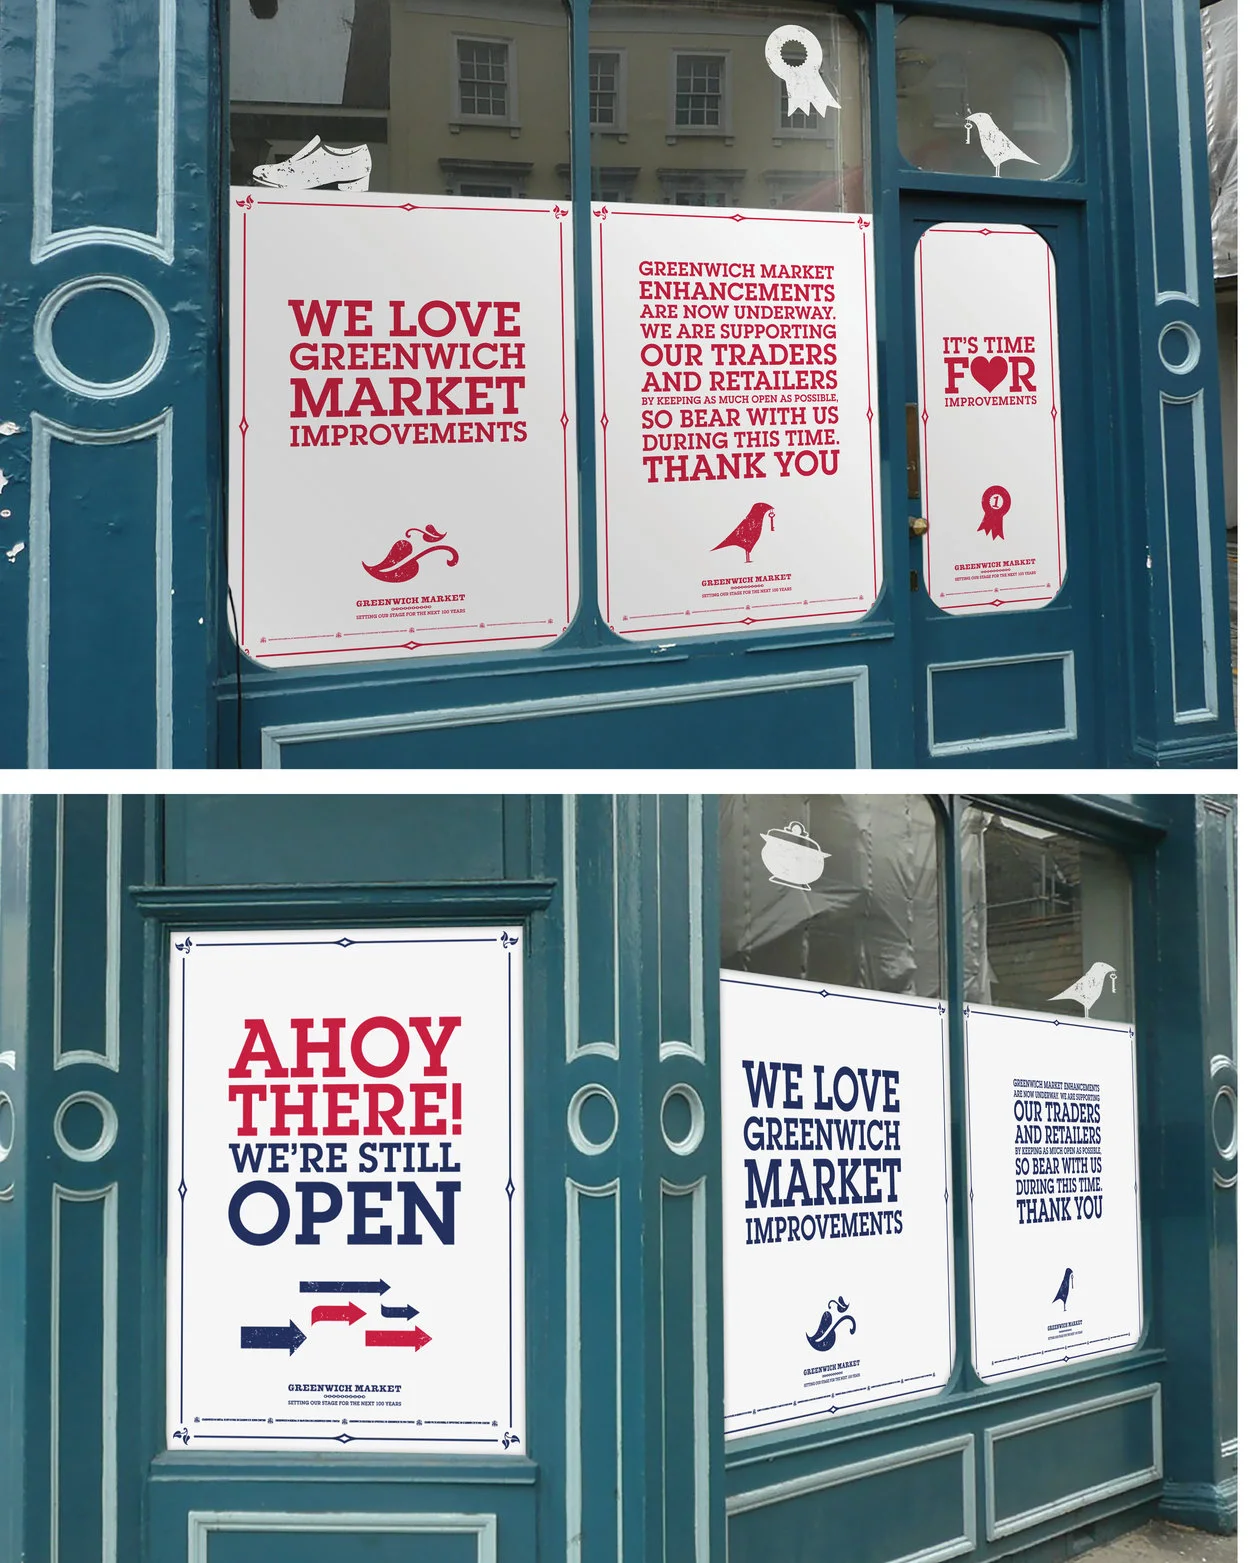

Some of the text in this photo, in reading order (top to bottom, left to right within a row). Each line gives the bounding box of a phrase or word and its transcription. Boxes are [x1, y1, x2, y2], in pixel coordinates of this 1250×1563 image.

[639, 261, 835, 280] GREENWICH MARKET
[639, 281, 835, 303] ENHANCEMENTS
[288, 299, 521, 338] WE LOVE
[640, 304, 836, 320] ARE NOW UNDERWAY.
[640, 323, 837, 339] WE ARE SUPPORTING
[290, 342, 526, 371] GREENWICH
[641, 343, 837, 367] OUR TRADERS
[943, 336, 1035, 354] IT'S TIME
[641, 370, 838, 393] AND RETAILERS
[290, 376, 526, 418] MARKET
[642, 394, 839, 406] BY KEEPING AS MUCH OPEN AS POSSIBLE,
[945, 395, 1037, 407] IMPROVEMENTS
[642, 406, 839, 429] SO BEAR WITH US
[290, 421, 527, 447] IMPROVEMENTS
[642, 429, 840, 452] DURING THIS TIME.
[643, 449, 840, 483] THANK YOU
[992, 495, 1000, 509] 1
[954, 559, 1036, 571] GREENWICH MARKET
[702, 574, 792, 587] GREENWICH MARKET
[356, 594, 466, 607] GREENWICH MARKET
[228, 1016, 462, 1079] AHOY
[742, 1060, 900, 1113] WE LOVE
[228, 1083, 462, 1136] THERE!
[1014, 1100, 1101, 1124] OUR TRADERS
[743, 1116, 901, 1151] GREENWICH
[1015, 1125, 1101, 1145] AND RETAILERS
[229, 1142, 461, 1173] WE'RE STILL
[1015, 1157, 1102, 1176] SO BEAR WITH US
[744, 1158, 902, 1209] MARKET
[1016, 1177, 1103, 1196] DURING THIS TIME.
[228, 1180, 461, 1246] OPEN
[1016, 1195, 1103, 1225] THANK YOU
[746, 1210, 903, 1245] IMPROVEMENTS
[288, 1384, 402, 1393] GREENWICH MARKET
